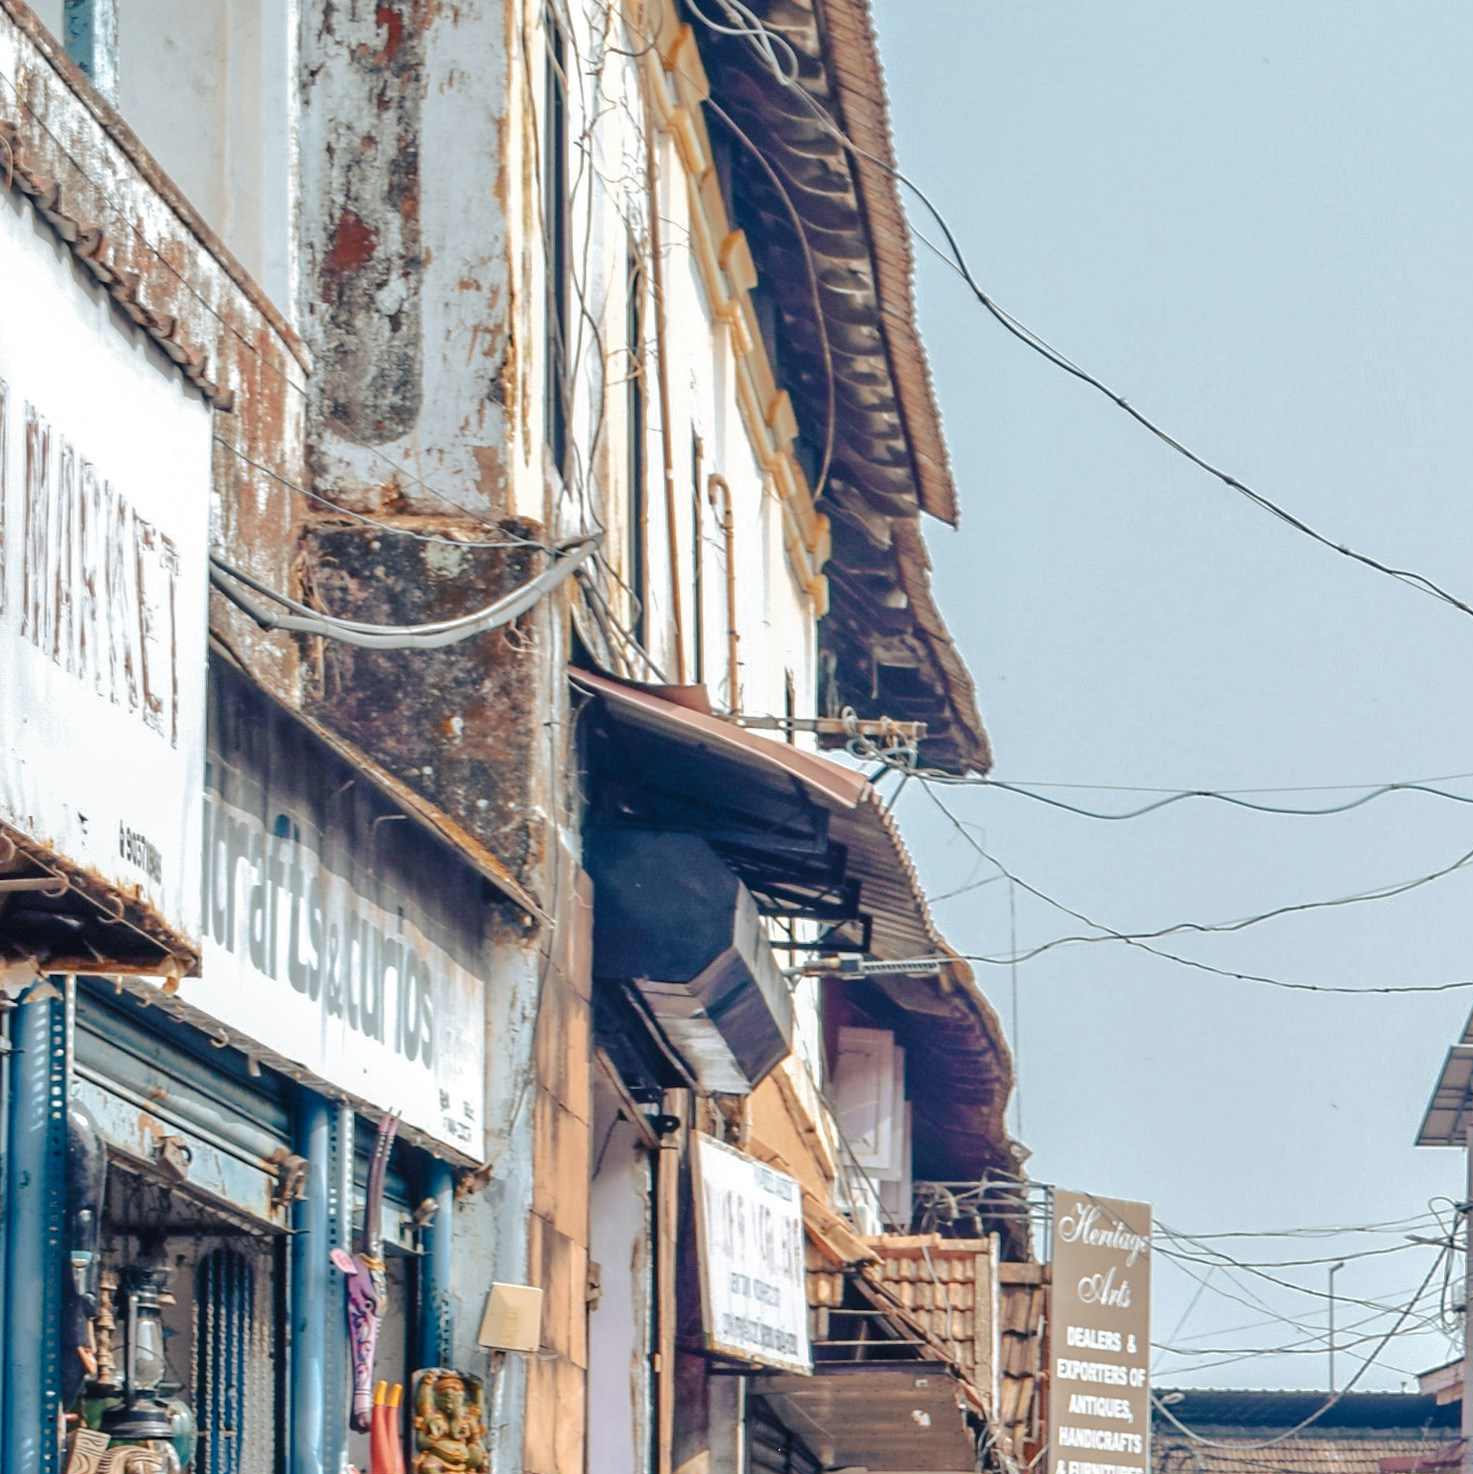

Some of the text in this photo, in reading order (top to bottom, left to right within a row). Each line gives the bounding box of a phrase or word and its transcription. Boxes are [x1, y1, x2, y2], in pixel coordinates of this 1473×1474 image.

[1058, 1202, 1150, 1267] Heritage
[1077, 1266, 1132, 1308] Arts
[1067, 1325, 1137, 1354] DEALERS &
[1056, 1358, 1147, 1388] EXPORTERS OF
[1068, 1393, 1133, 1424] ANTIQUES,
[1058, 1426, 1143, 1454] HANDICRAFTS
